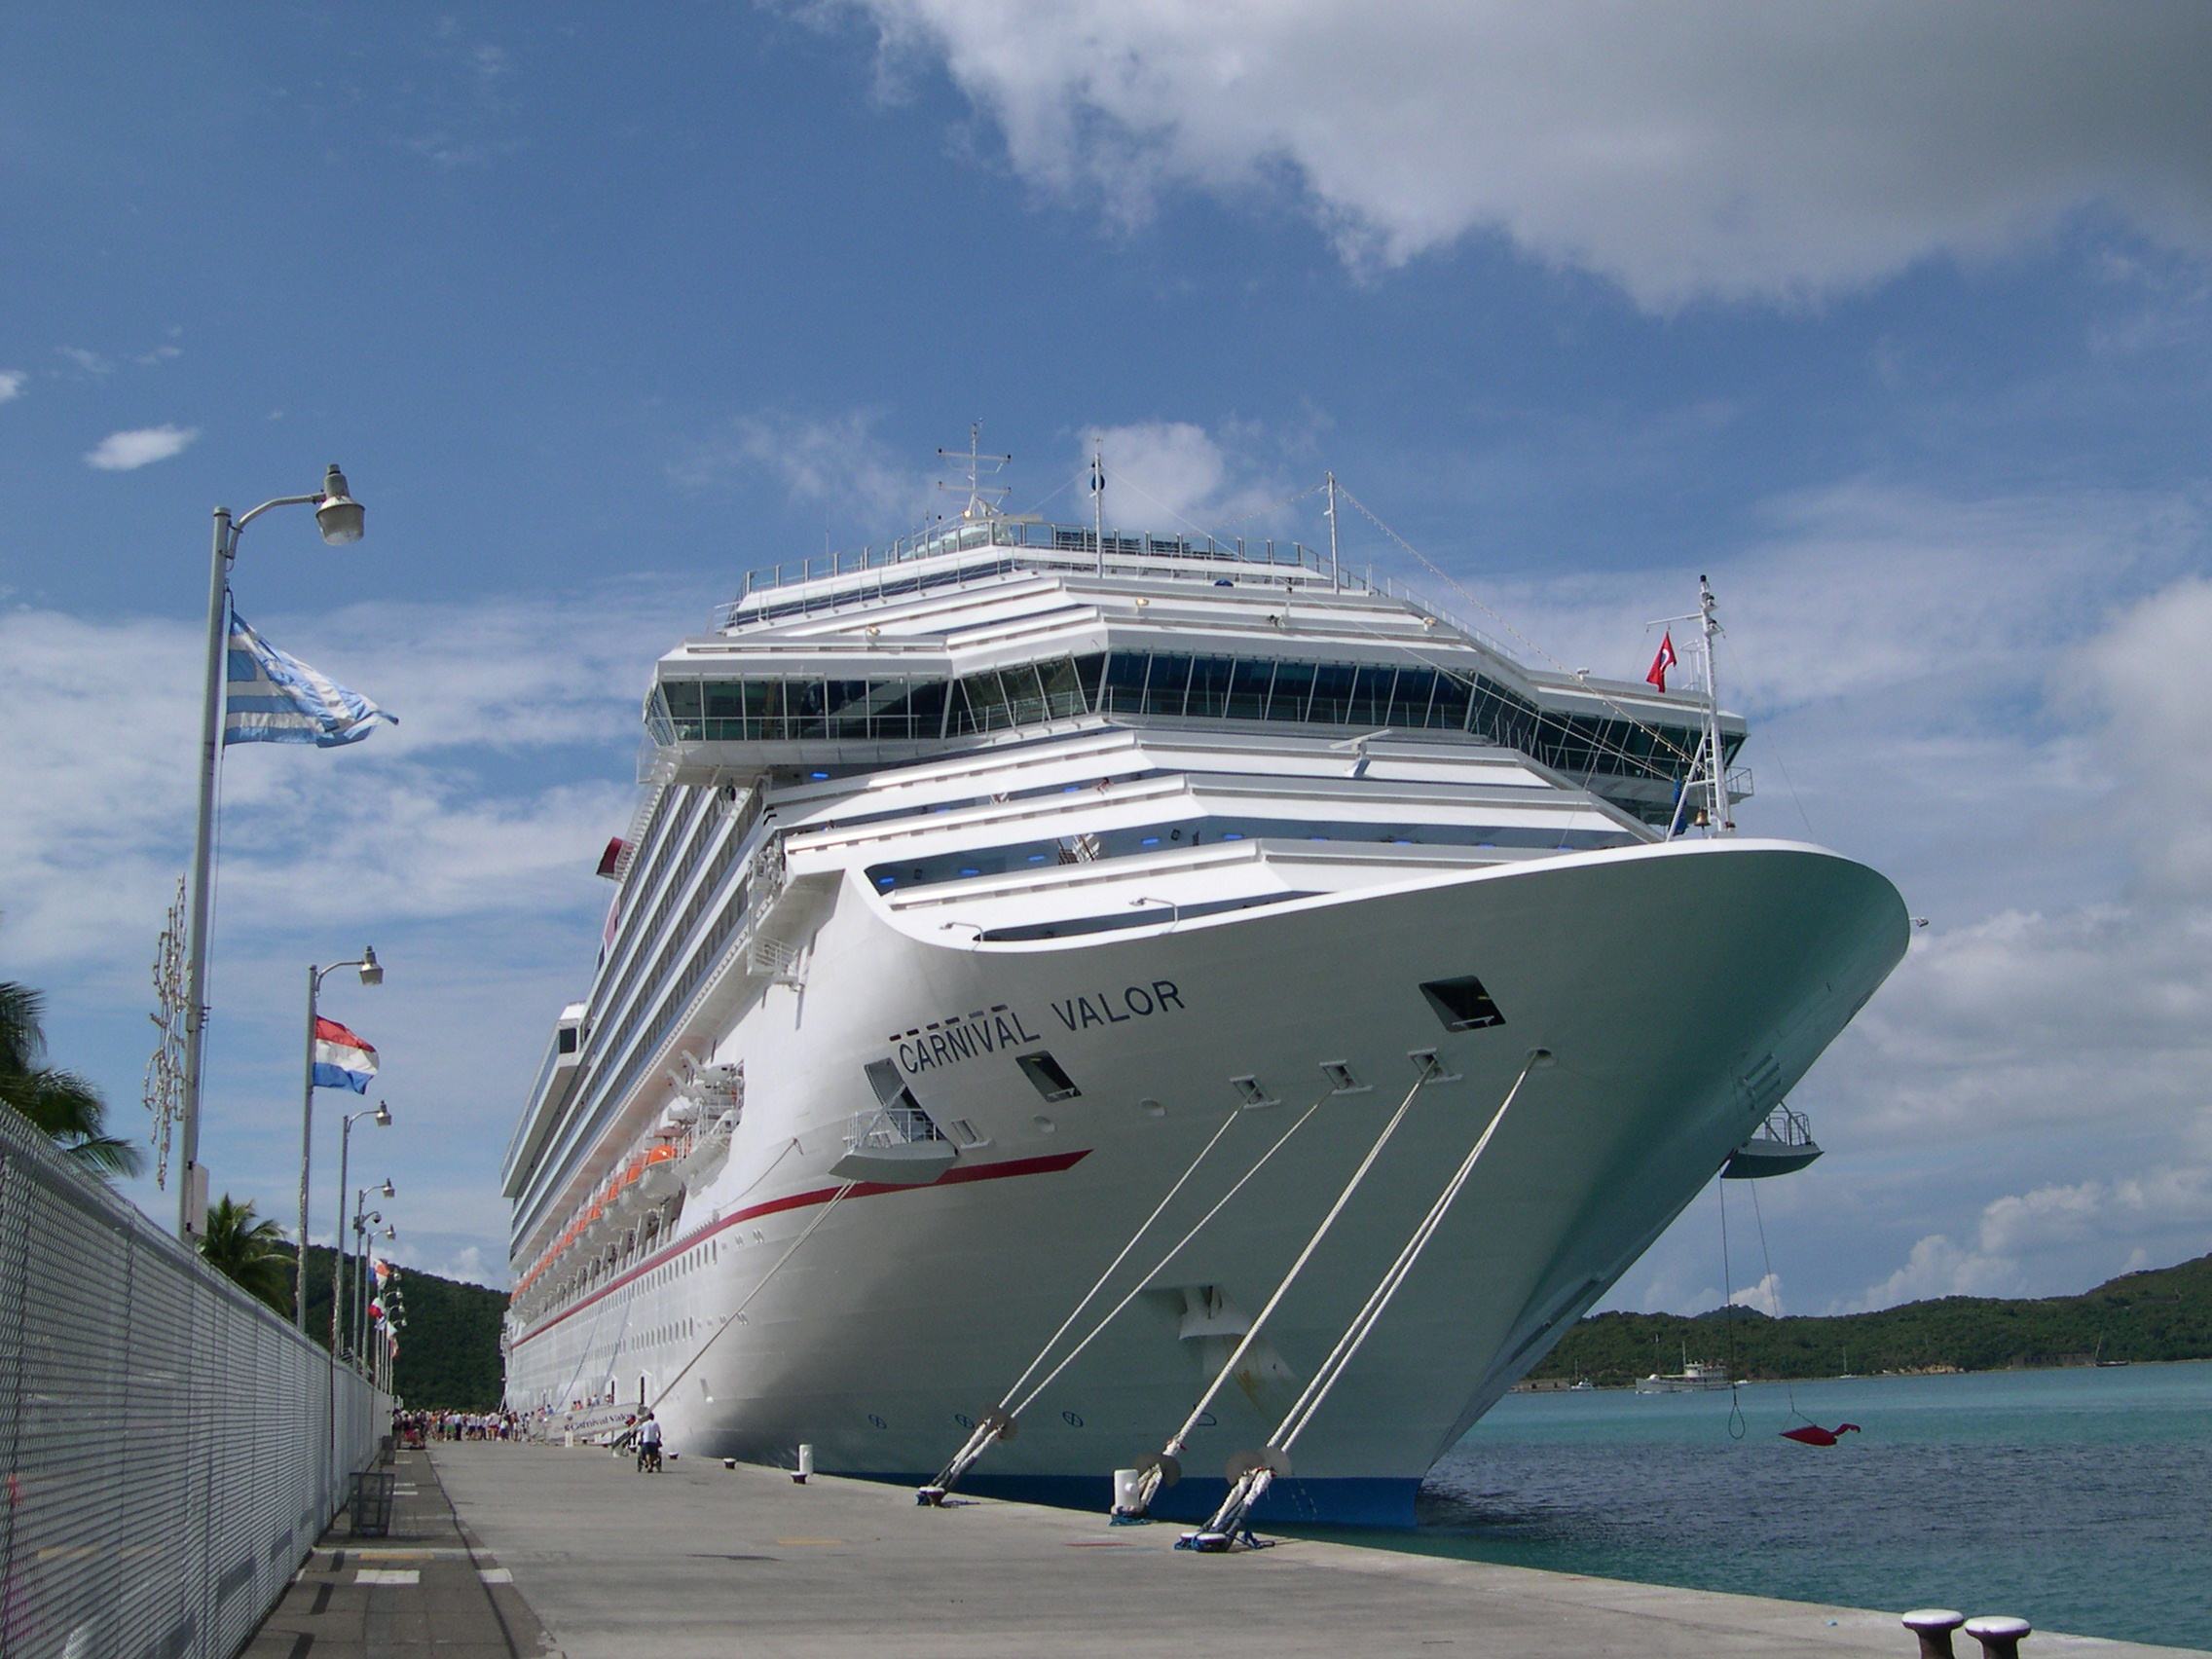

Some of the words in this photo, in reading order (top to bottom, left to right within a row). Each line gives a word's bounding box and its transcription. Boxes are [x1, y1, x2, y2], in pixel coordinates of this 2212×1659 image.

[899, 1013, 1041, 1074] CARNIVAL
[1051, 980, 1185, 1032] VALOR
[571, 1416, 608, 1430] Carnival
